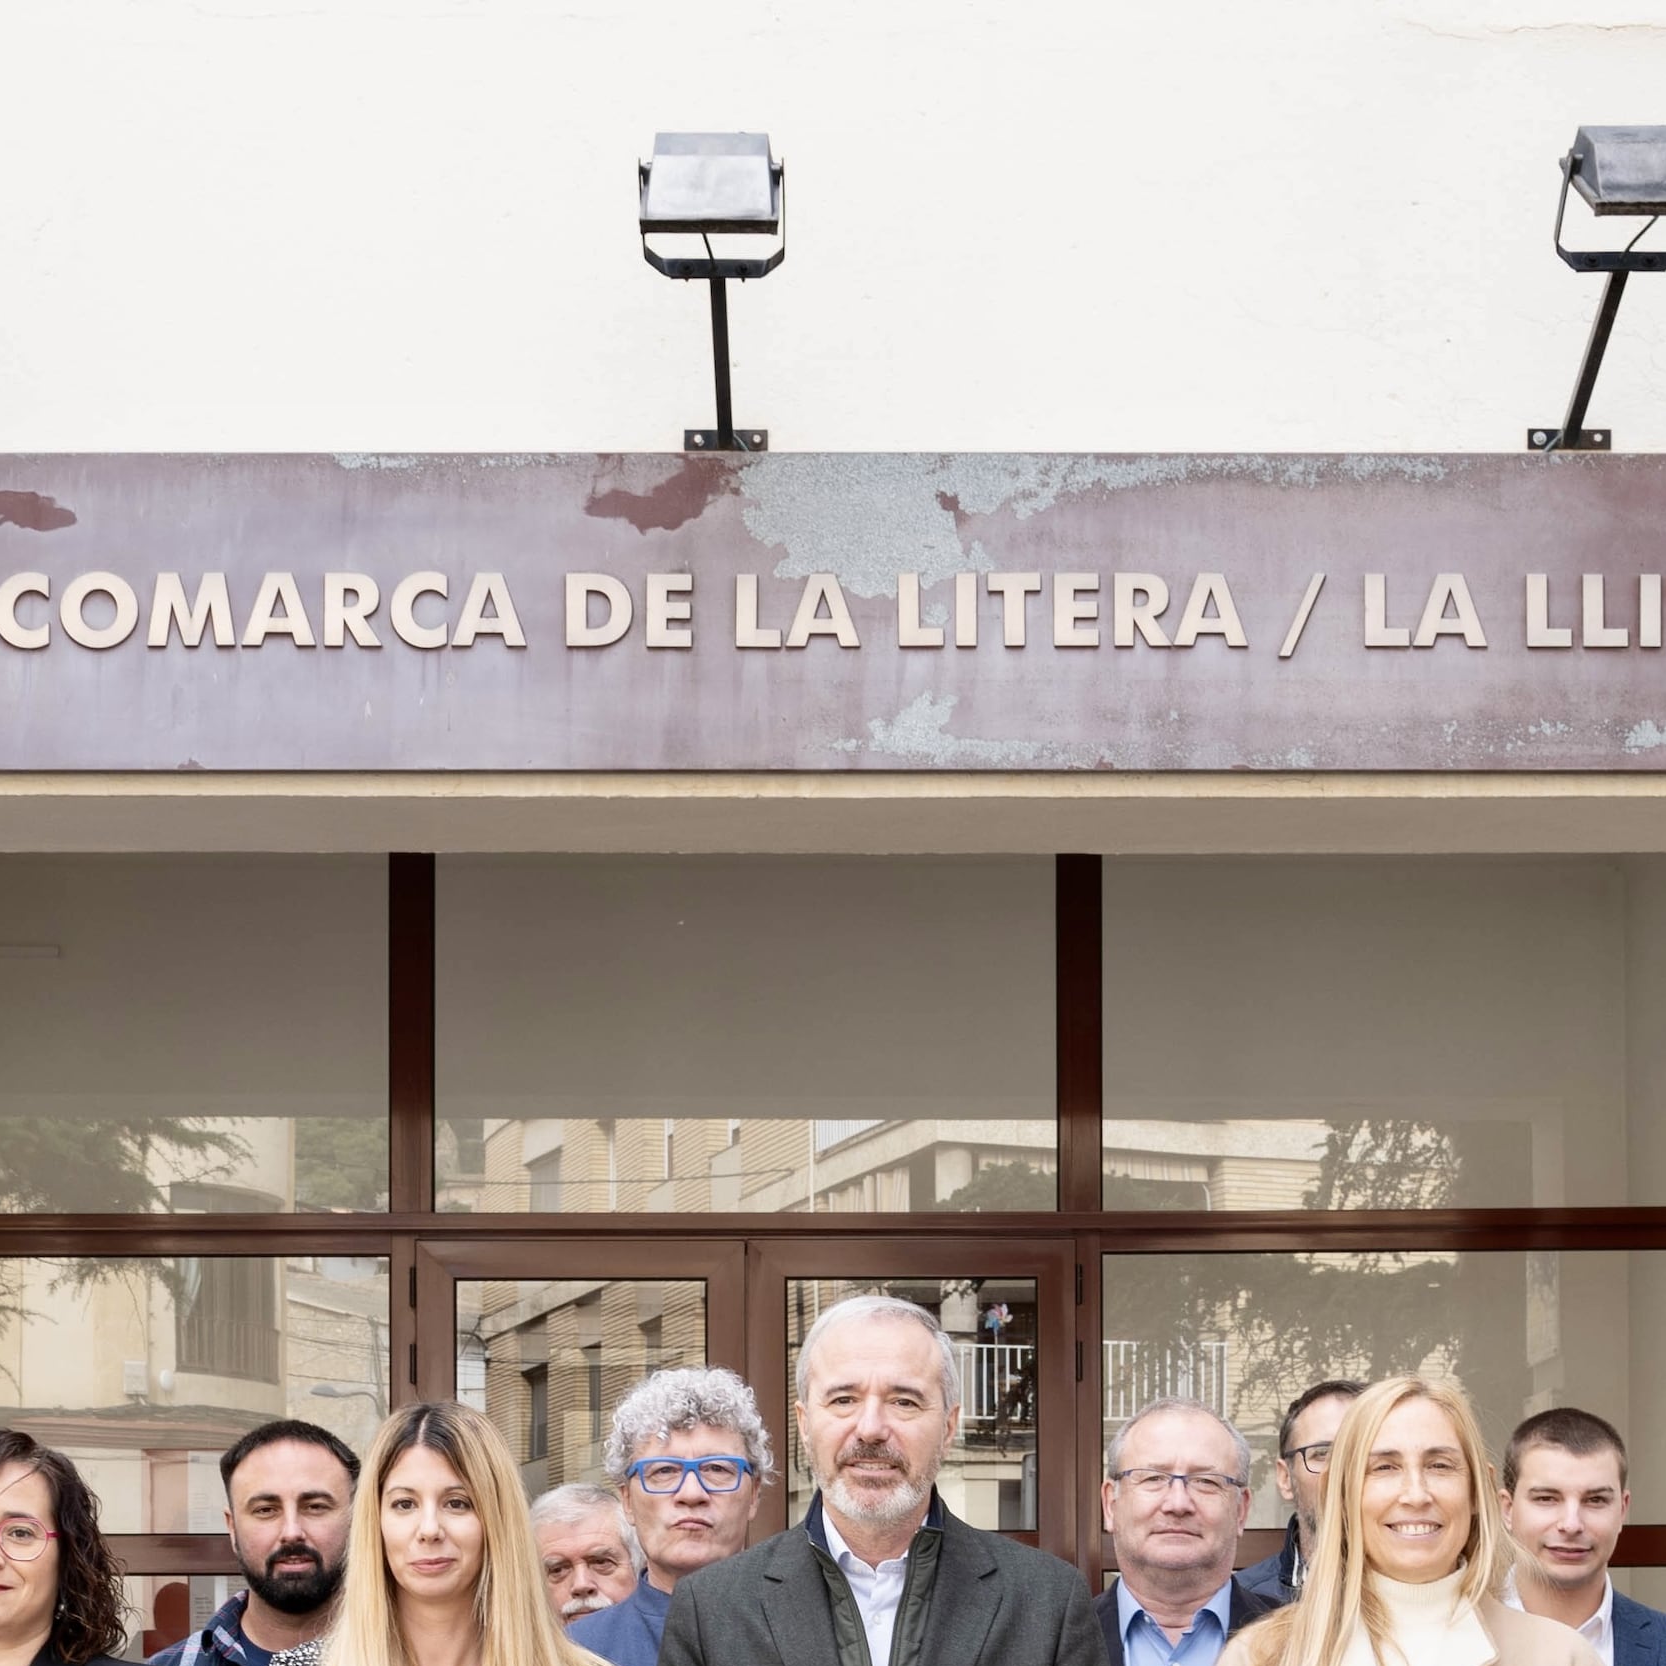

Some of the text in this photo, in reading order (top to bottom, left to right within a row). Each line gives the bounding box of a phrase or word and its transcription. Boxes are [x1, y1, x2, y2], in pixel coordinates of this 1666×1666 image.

[565, 572, 692, 648] DE
[735, 573, 861, 648] LA
[898, 572, 1248, 648] LITERA
[1278, 573, 1325, 657] /
[1364, 573, 1488, 648] LA
